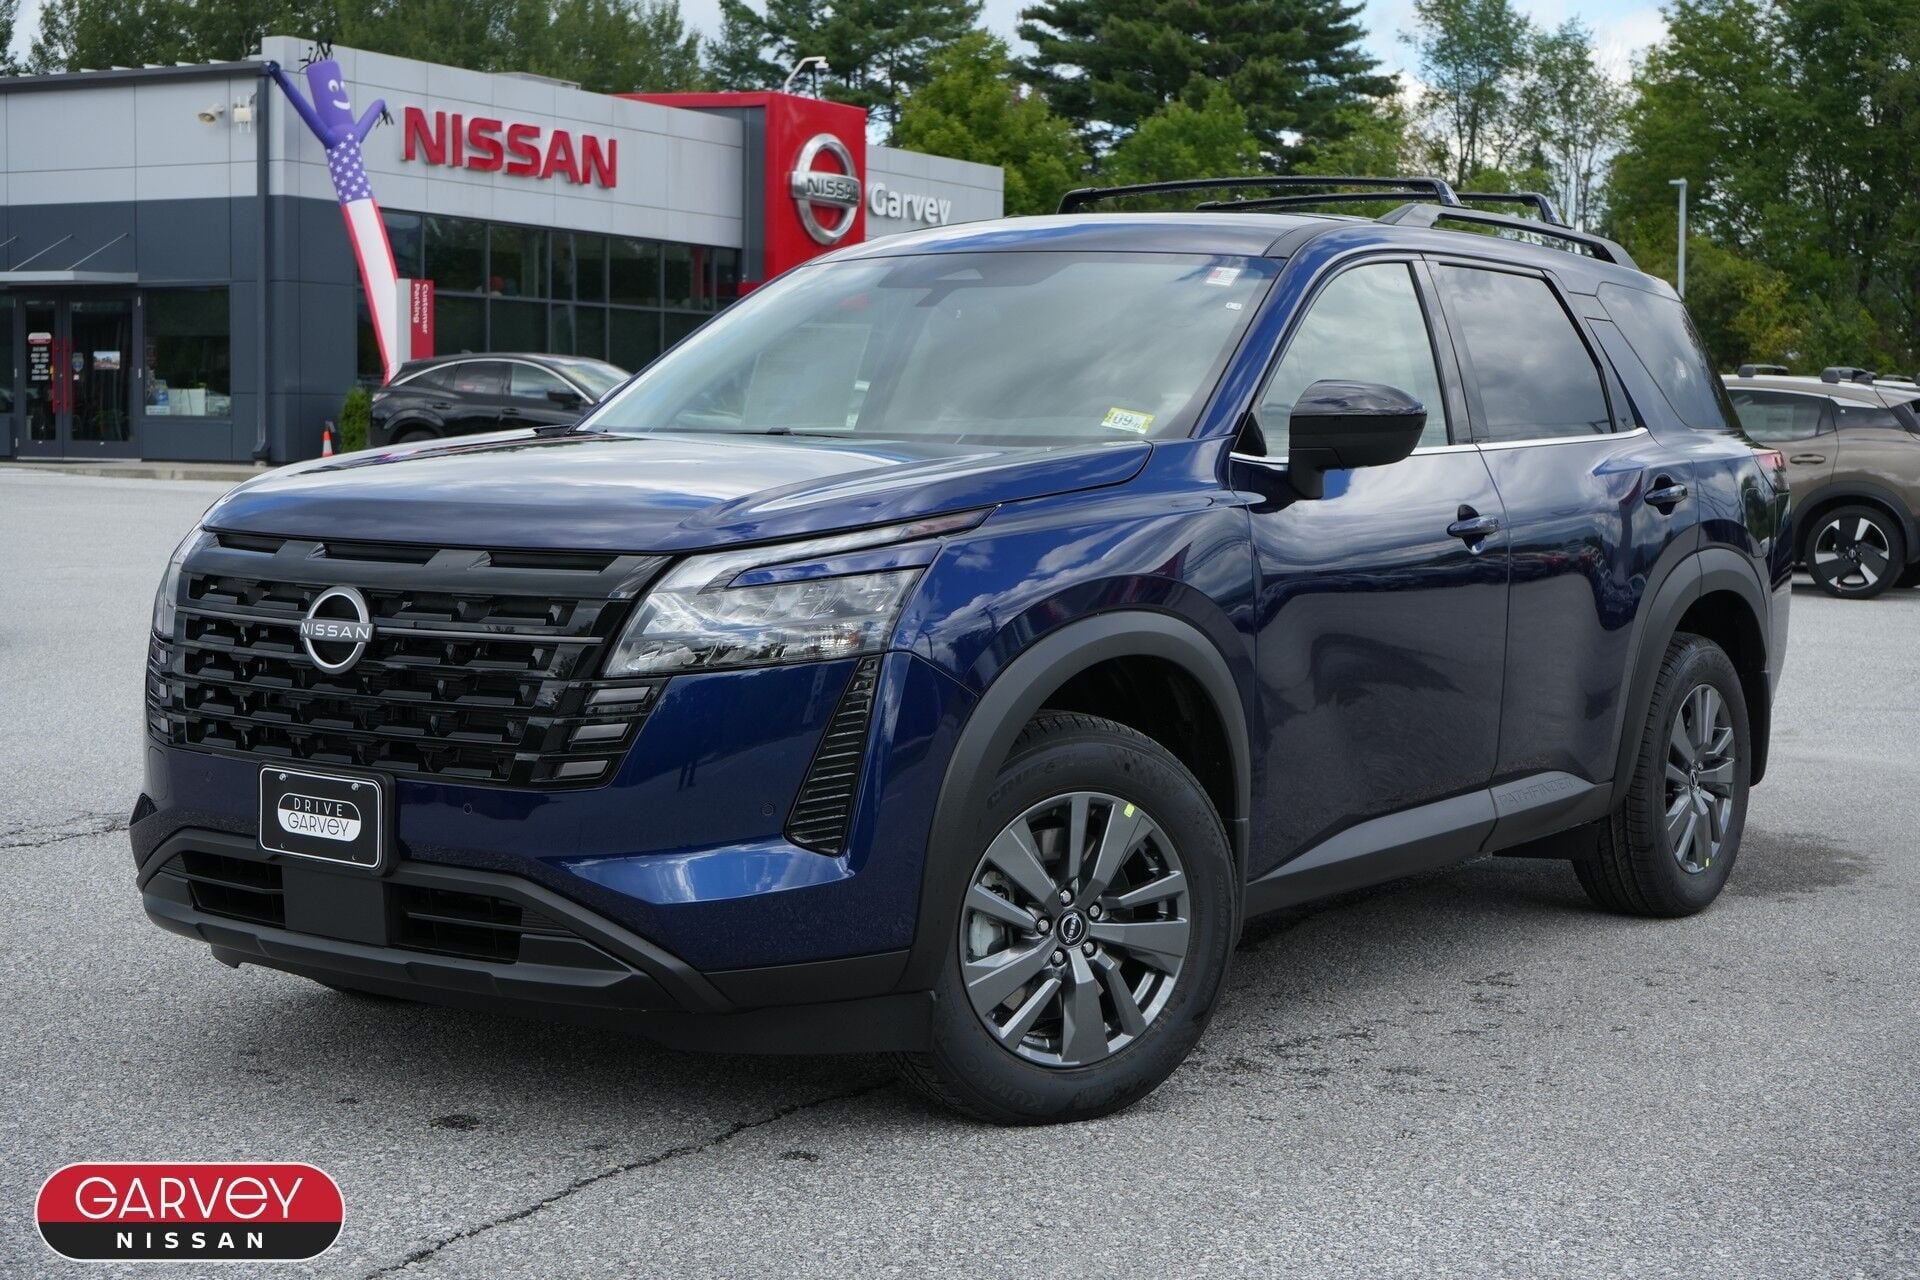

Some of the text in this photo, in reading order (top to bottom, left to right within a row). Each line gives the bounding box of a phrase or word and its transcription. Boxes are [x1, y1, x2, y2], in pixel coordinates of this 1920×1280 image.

[403, 106, 617, 188] NISSAN
[806, 175, 859, 201] NISSAN
[869, 182, 953, 226] Garvey
[413, 283, 421, 323] Parking
[300, 620, 372, 642] NISSAN
[293, 797, 343, 817] DRIVE
